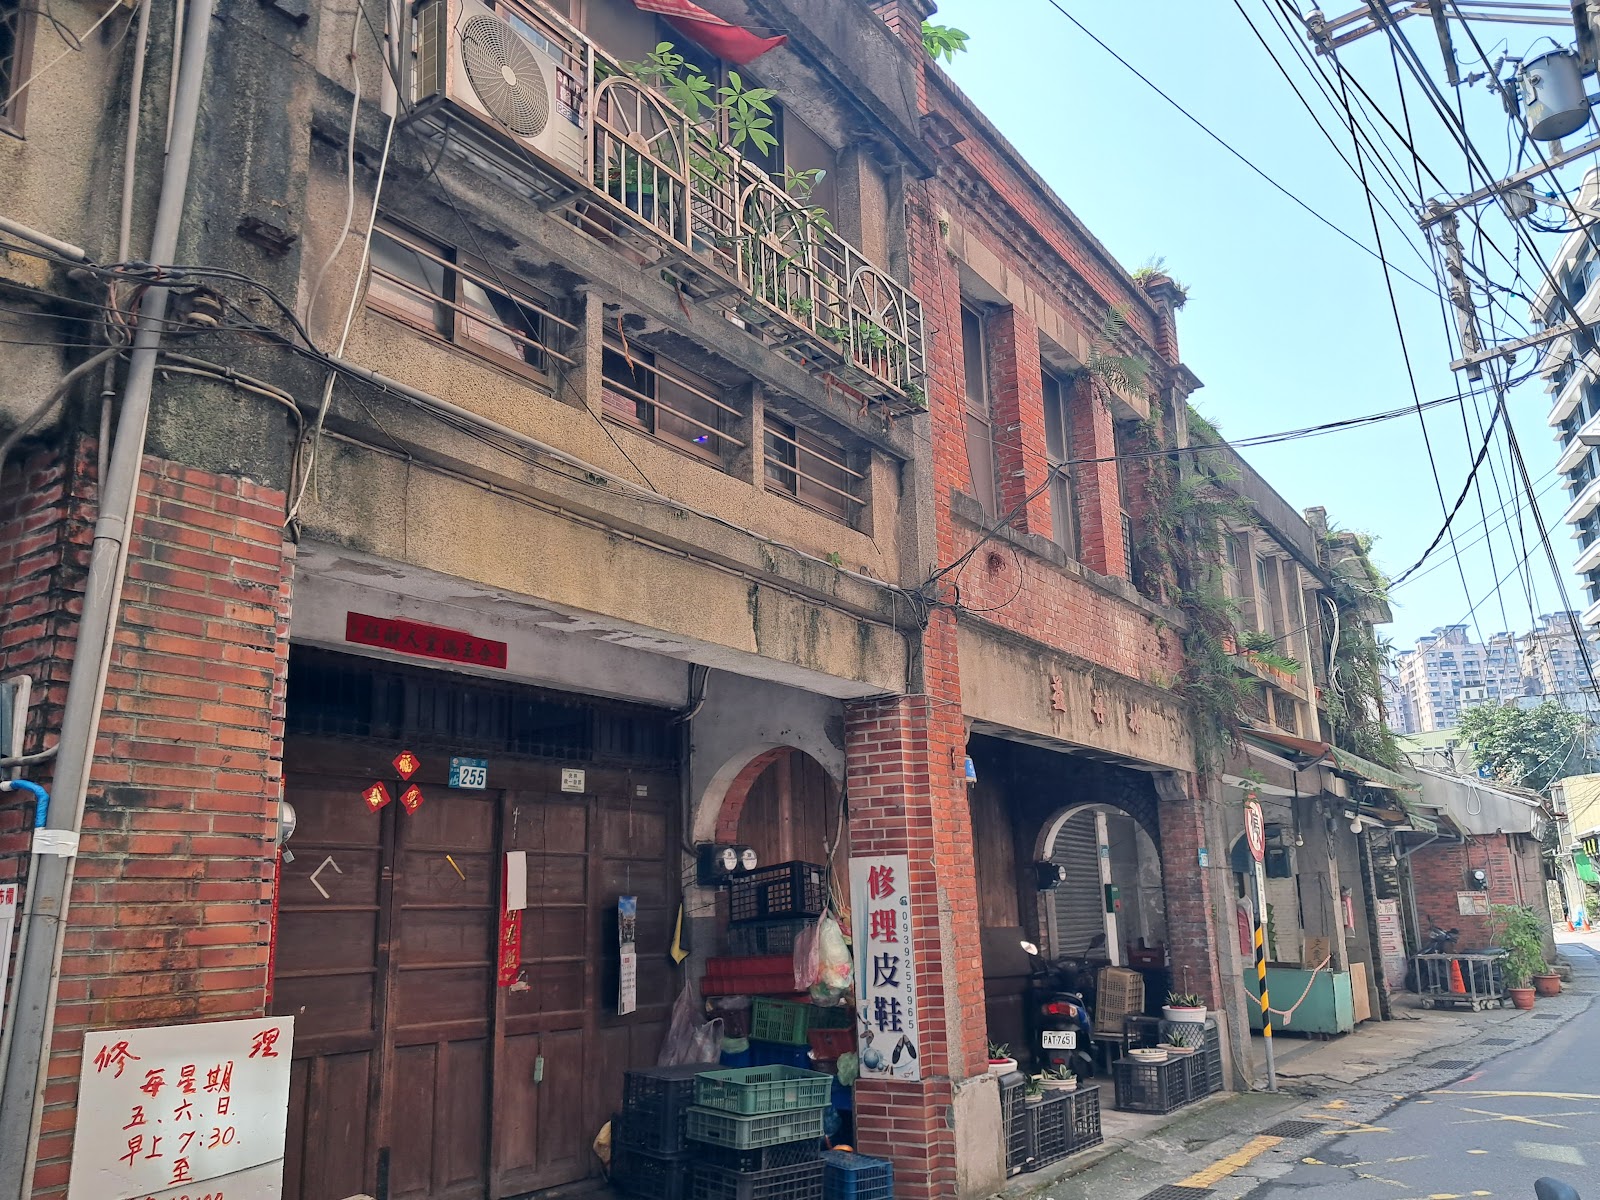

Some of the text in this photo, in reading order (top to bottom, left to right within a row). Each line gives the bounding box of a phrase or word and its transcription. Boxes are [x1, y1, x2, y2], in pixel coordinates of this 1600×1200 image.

[461, 768, 485, 786] 255
[867, 864, 903, 1033] 修理皮鞋
[902, 911, 914, 1030] 0939255965
[93, 1027, 281, 1079] 修 理
[140, 1061, 234, 1097] 每星期
[167, 1156, 194, 1185] 至
